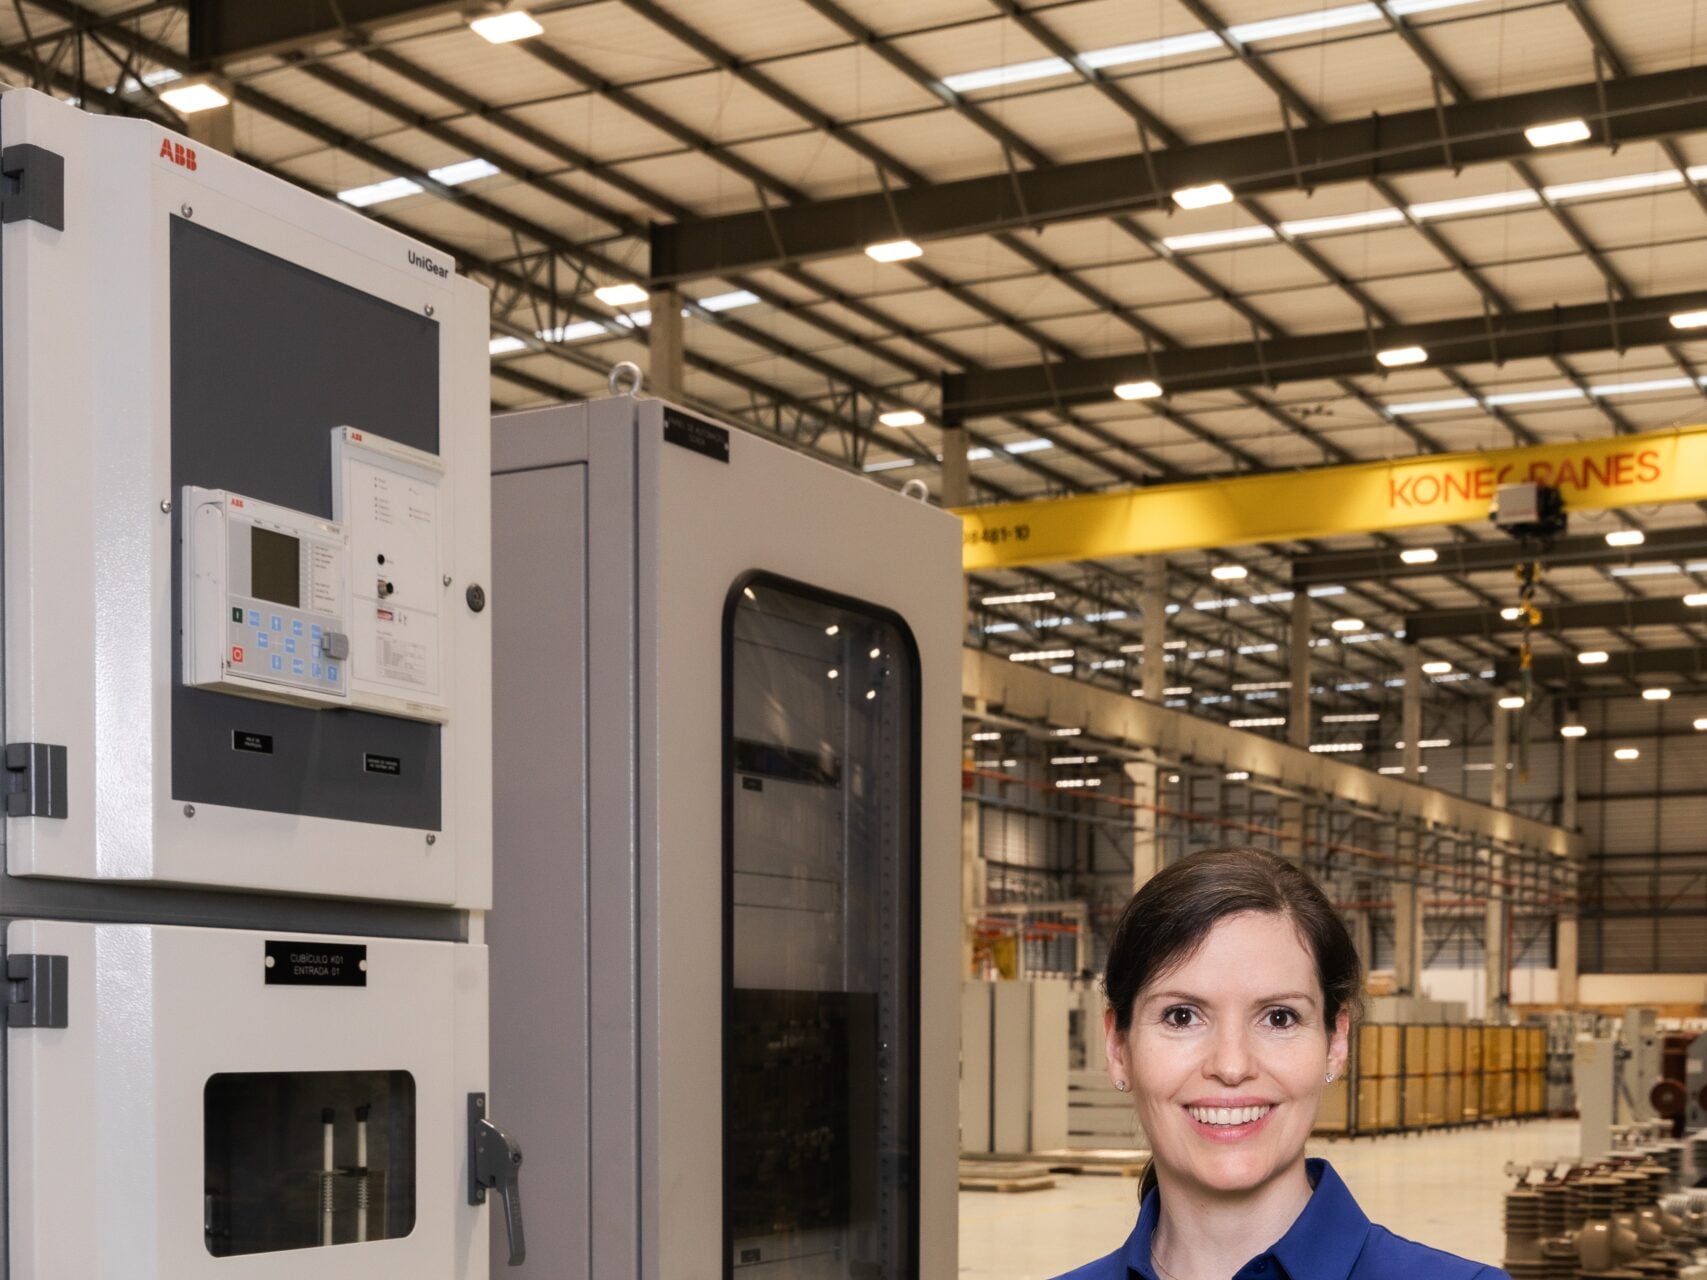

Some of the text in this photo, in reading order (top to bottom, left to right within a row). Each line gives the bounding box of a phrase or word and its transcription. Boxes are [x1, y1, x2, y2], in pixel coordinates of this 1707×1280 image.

[160, 137, 197, 171] ABB
[408, 249, 449, 279] UniGear
[231, 497, 245, 508] ABB
[294, 966, 329, 976] ENTRADA
